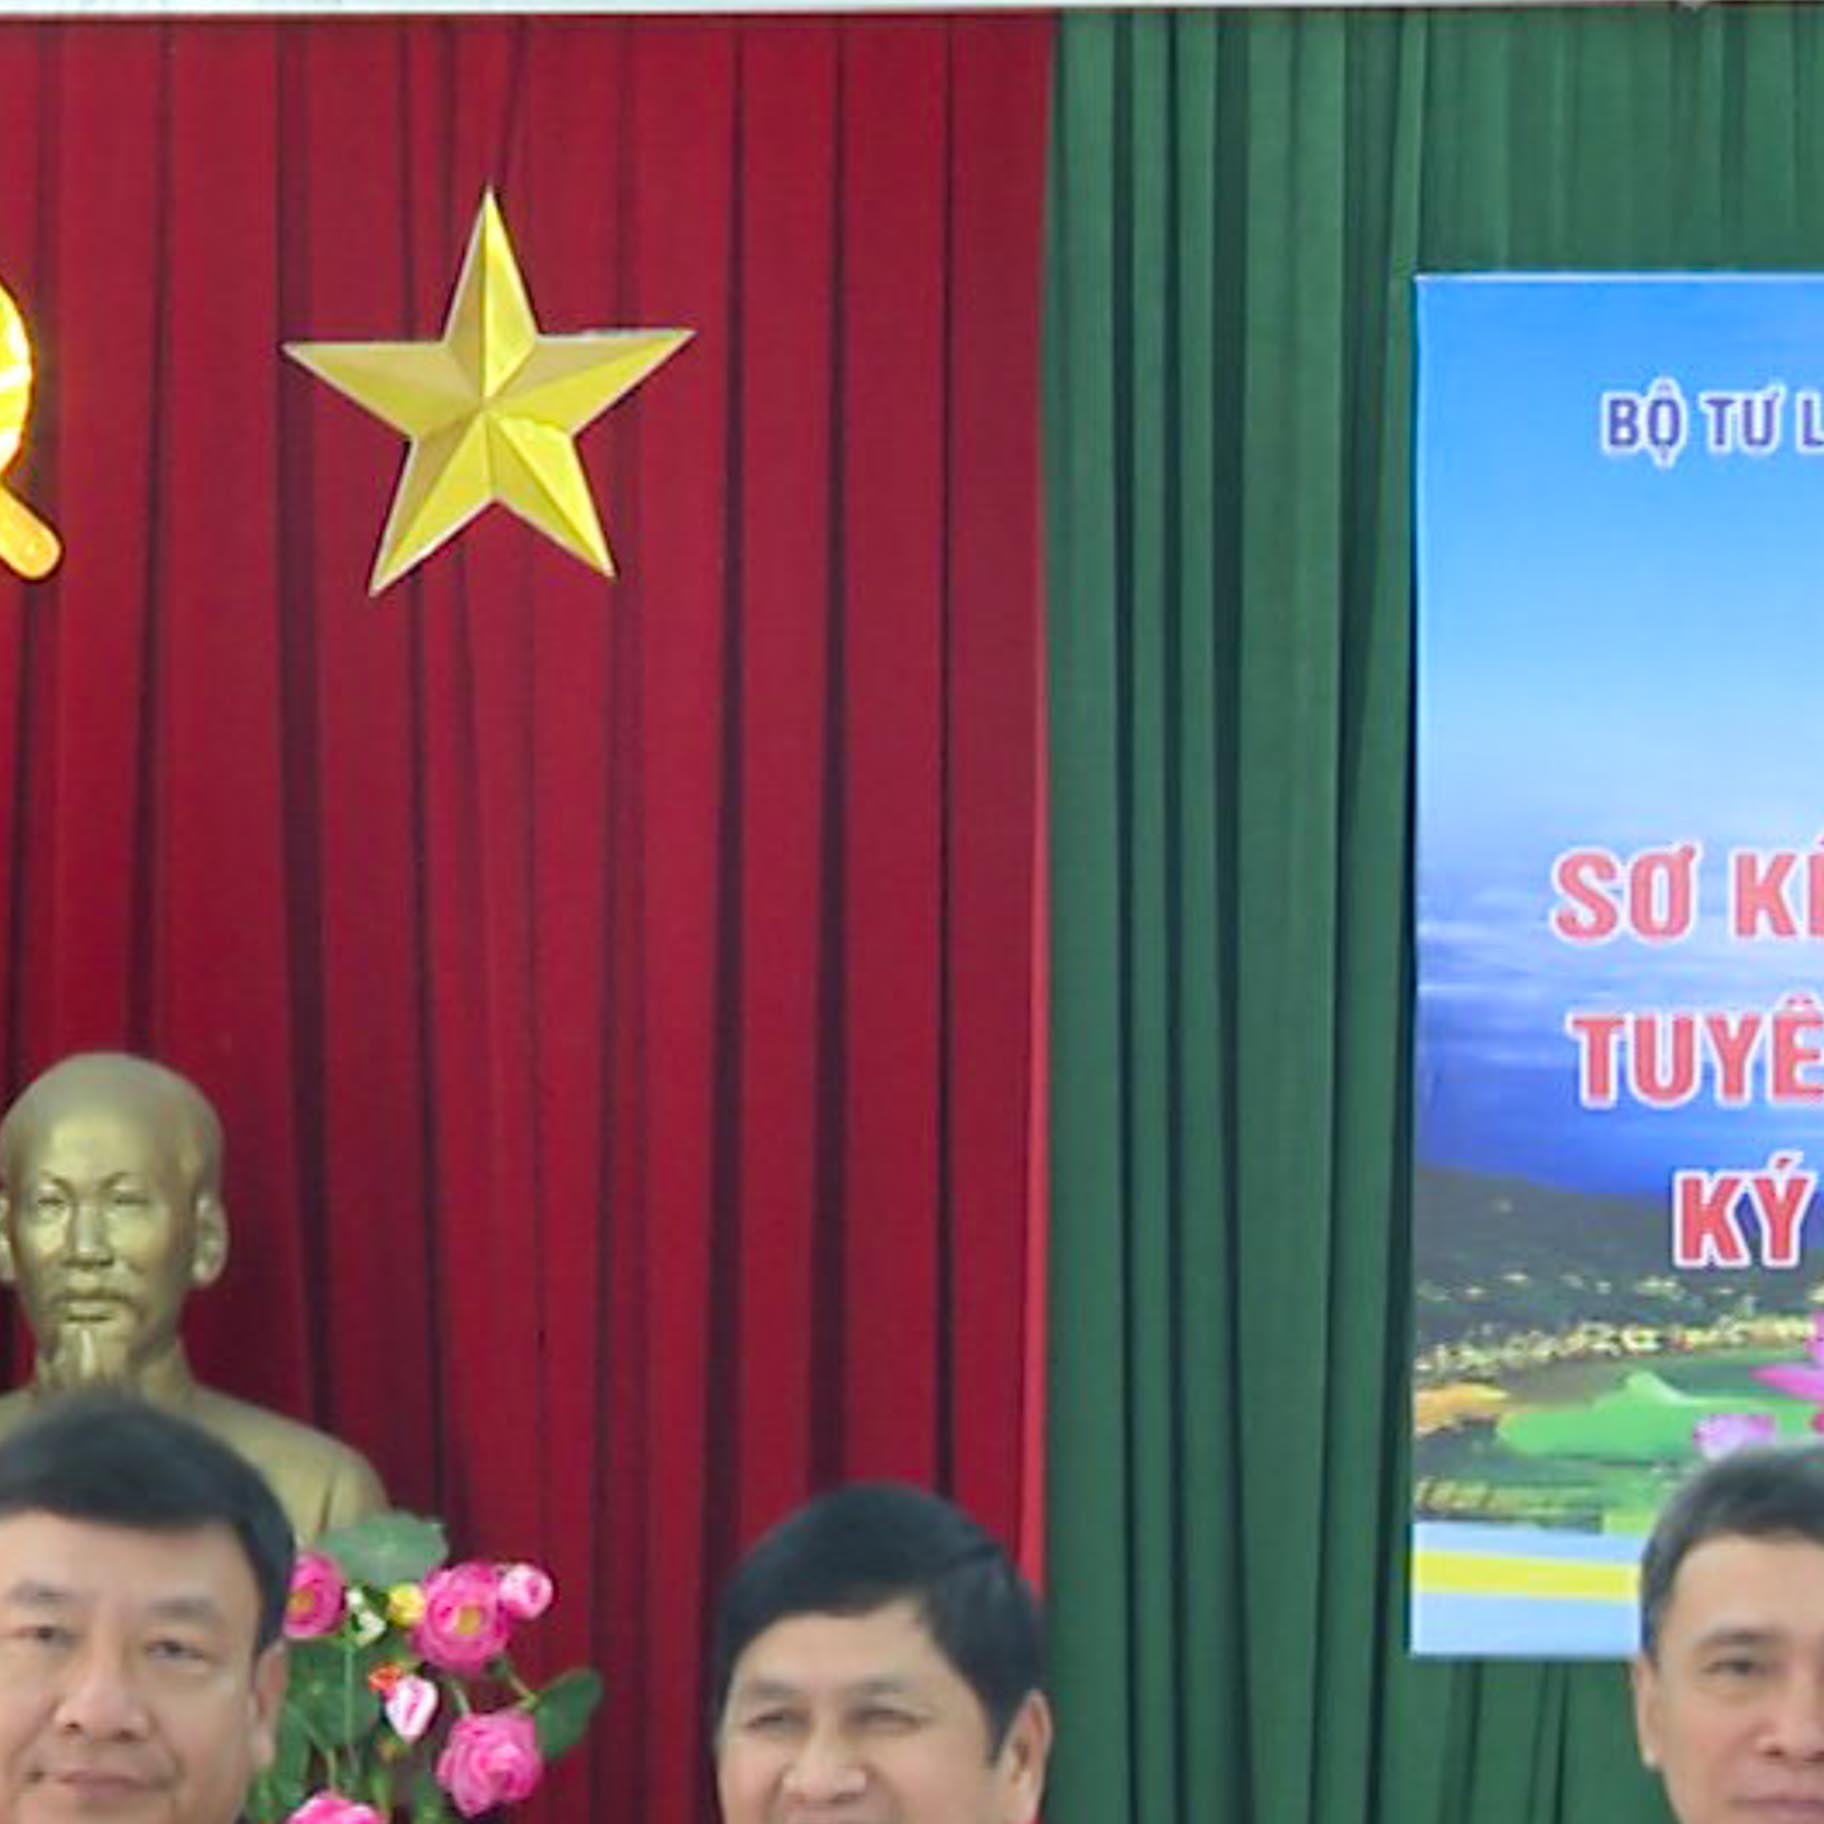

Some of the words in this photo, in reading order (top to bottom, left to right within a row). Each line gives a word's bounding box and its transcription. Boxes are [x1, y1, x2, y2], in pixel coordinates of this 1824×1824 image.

[1606, 378, 1683, 462] BỘ
[1702, 390, 1782, 448] TƯ
[1552, 842, 1698, 938] SƠ
[1675, 1154, 1810, 1264] KÝ
